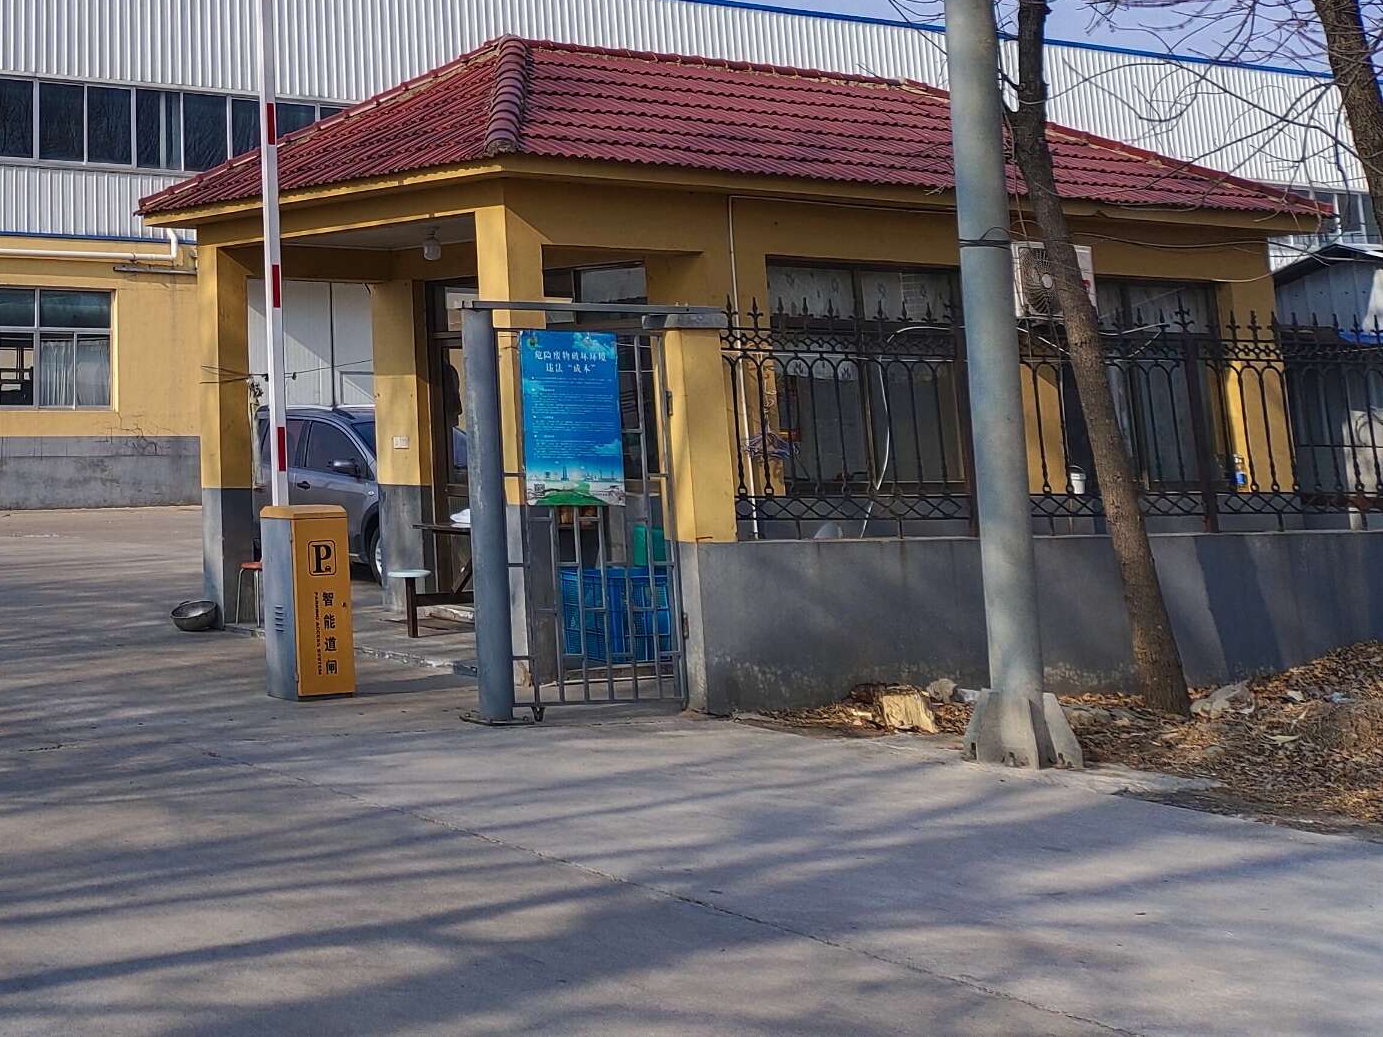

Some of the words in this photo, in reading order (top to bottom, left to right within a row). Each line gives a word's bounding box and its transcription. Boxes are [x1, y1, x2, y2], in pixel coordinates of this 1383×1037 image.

[312, 544, 332, 573] P
[322, 592, 338, 675] 智能道闸
